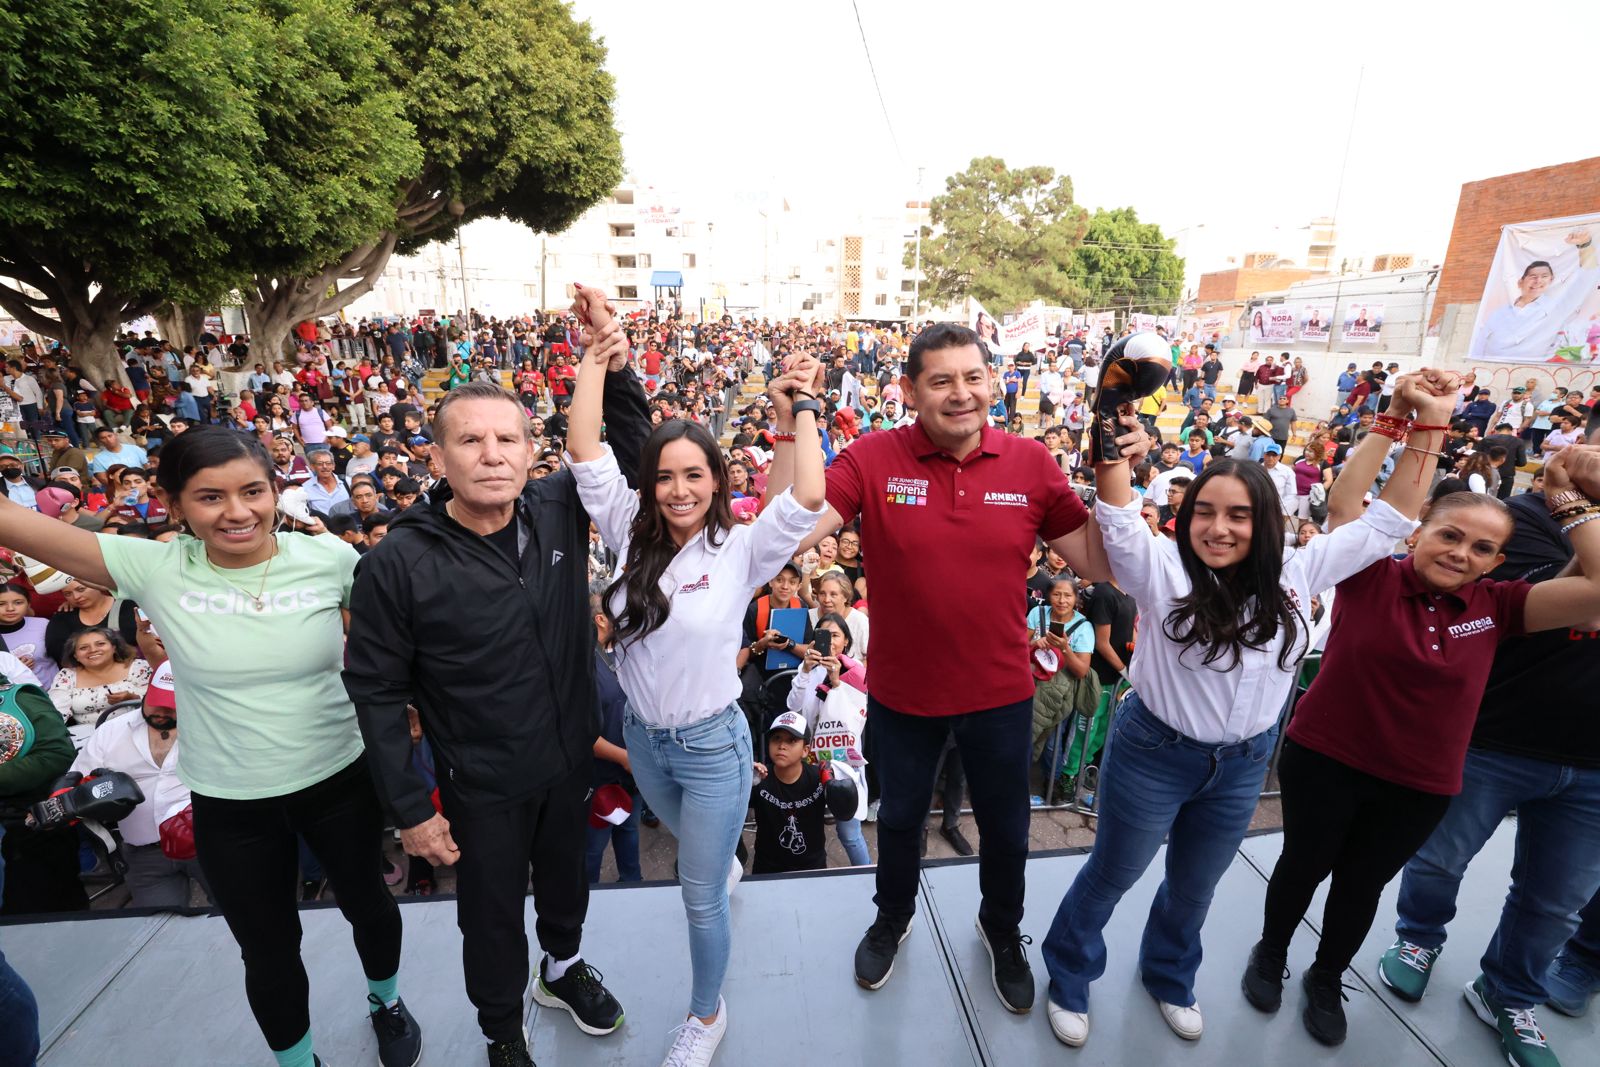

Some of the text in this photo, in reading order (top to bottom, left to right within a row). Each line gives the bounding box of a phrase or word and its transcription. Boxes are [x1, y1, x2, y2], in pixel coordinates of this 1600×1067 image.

[887, 484, 928, 496] morena
[984, 492, 1028, 504] ARMENTA
[179, 587, 321, 616] adidas
[1447, 616, 1493, 635] morena
[818, 721, 844, 730] VOTA
